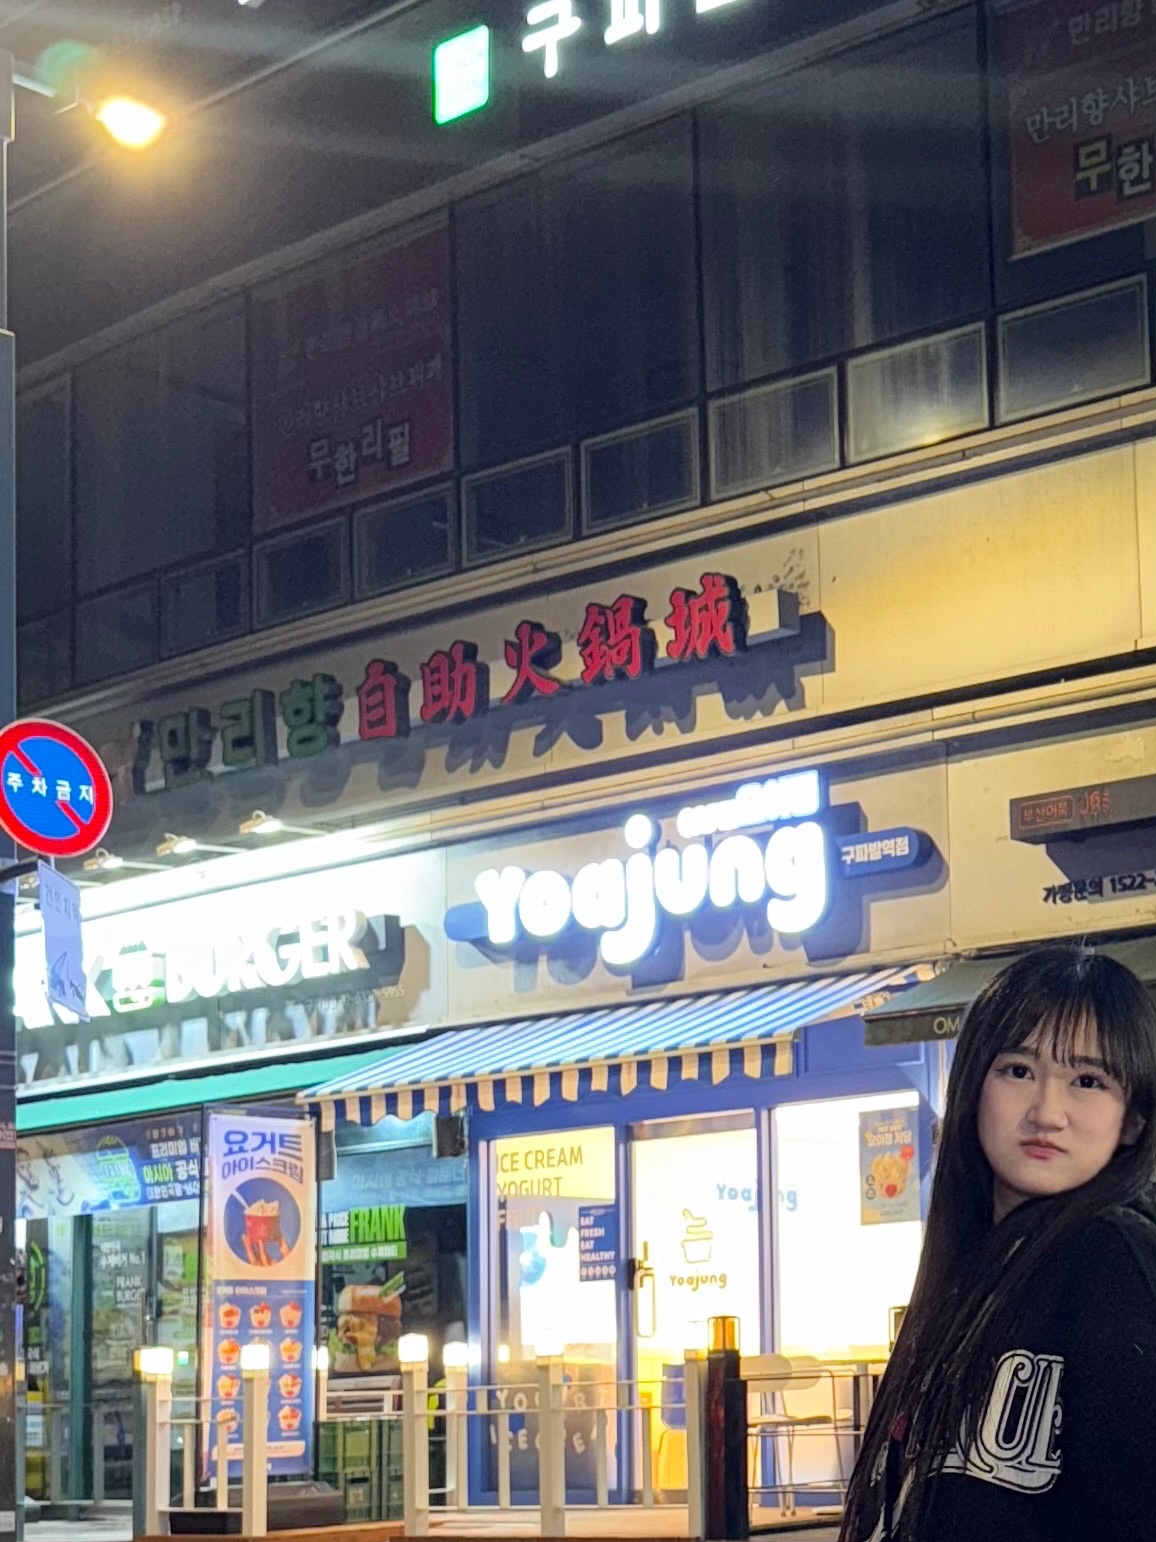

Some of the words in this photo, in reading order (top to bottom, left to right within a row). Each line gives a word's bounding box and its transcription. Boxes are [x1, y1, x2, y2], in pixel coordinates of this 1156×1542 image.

[308, 418, 411, 486] 무한리필
[157, 672, 334, 790] 만리향
[357, 572, 737, 741] 自助火鍋城
[841, 835, 911, 865] 구파발역점
[475, 814, 829, 966] Yoajung
[163, 908, 368, 1004] BURGER
[223, 1129, 304, 1163] 요거트
[524, 1145, 584, 1171] CREAM
[221, 1155, 304, 1186] 아이스크림
[349, 1203, 406, 1245] FRANK
[669, 1270, 728, 1292] Yoajung
